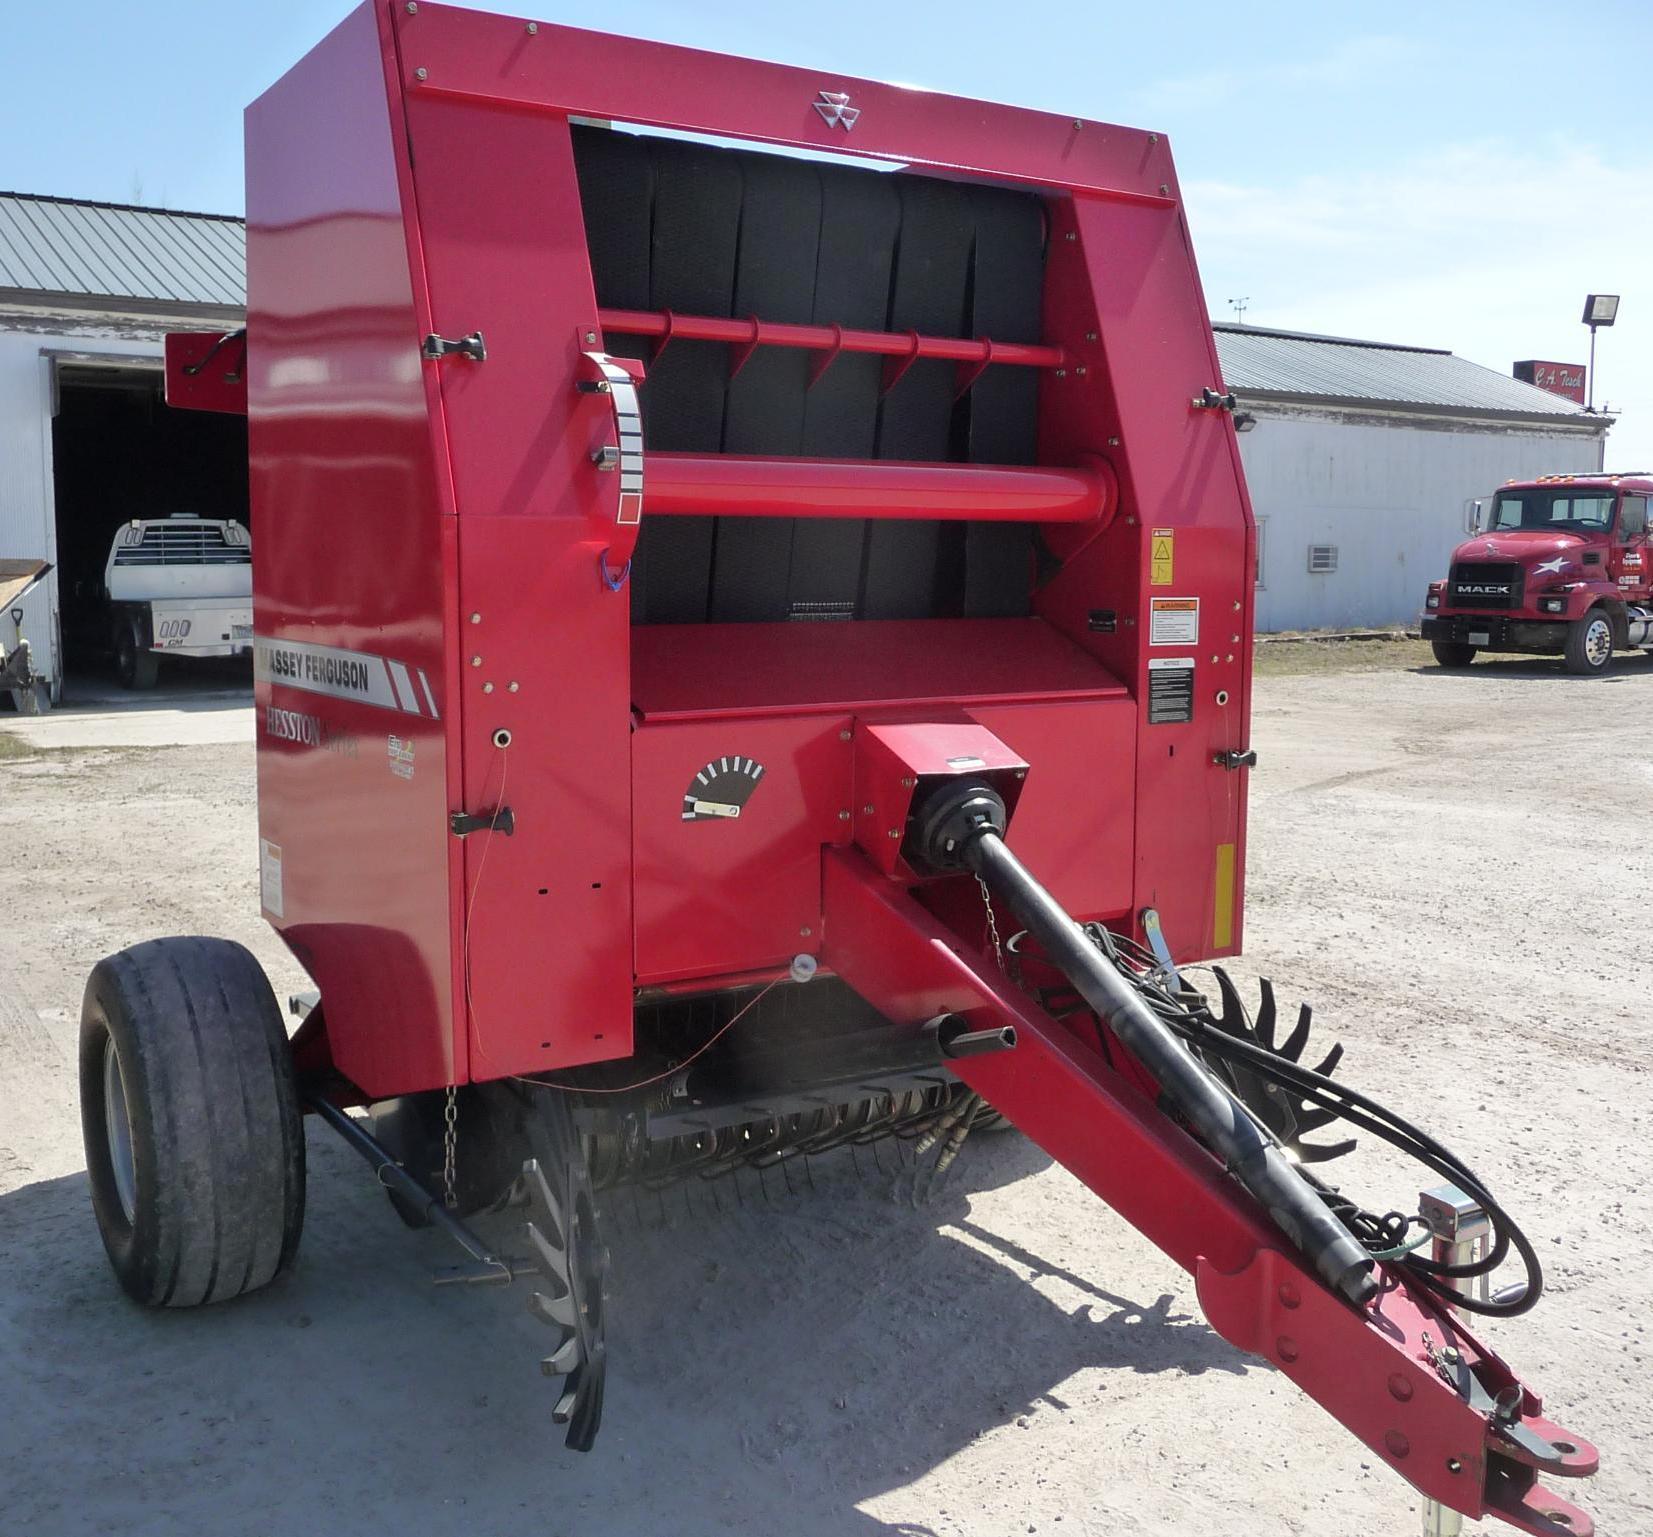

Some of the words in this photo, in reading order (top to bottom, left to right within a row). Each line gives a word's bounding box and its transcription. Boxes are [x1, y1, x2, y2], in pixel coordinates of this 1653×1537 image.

[1457, 585, 1510, 594] MACK
[305, 653, 369, 691] FERGUSON
[266, 705, 321, 747] HESSTON
